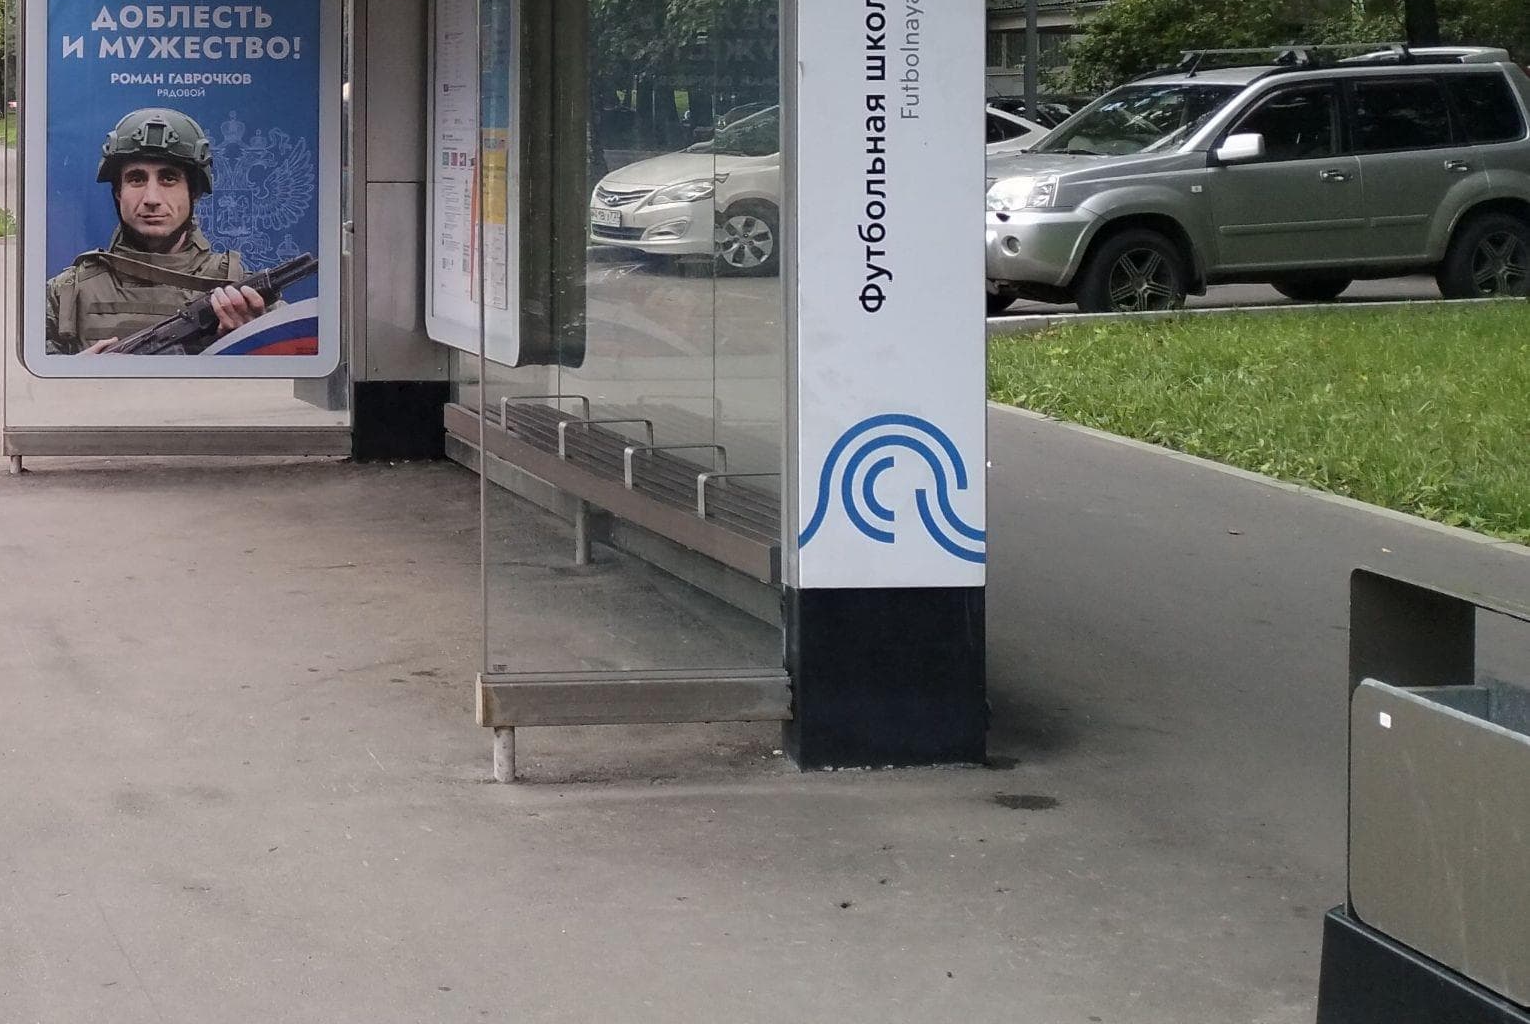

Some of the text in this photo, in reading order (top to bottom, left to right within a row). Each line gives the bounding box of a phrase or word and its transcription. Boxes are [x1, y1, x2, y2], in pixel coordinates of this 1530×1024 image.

[91, 4, 273, 32] ДОБЛЕСТЬ
[62, 35, 301, 60] И МУЖЕСТВО!
[110, 72, 253, 86] РОМАН ГАВРОЧКОВ
[156, 86, 206, 98] РЯДОВОЙ
[858, 94, 892, 314] Футбольная
